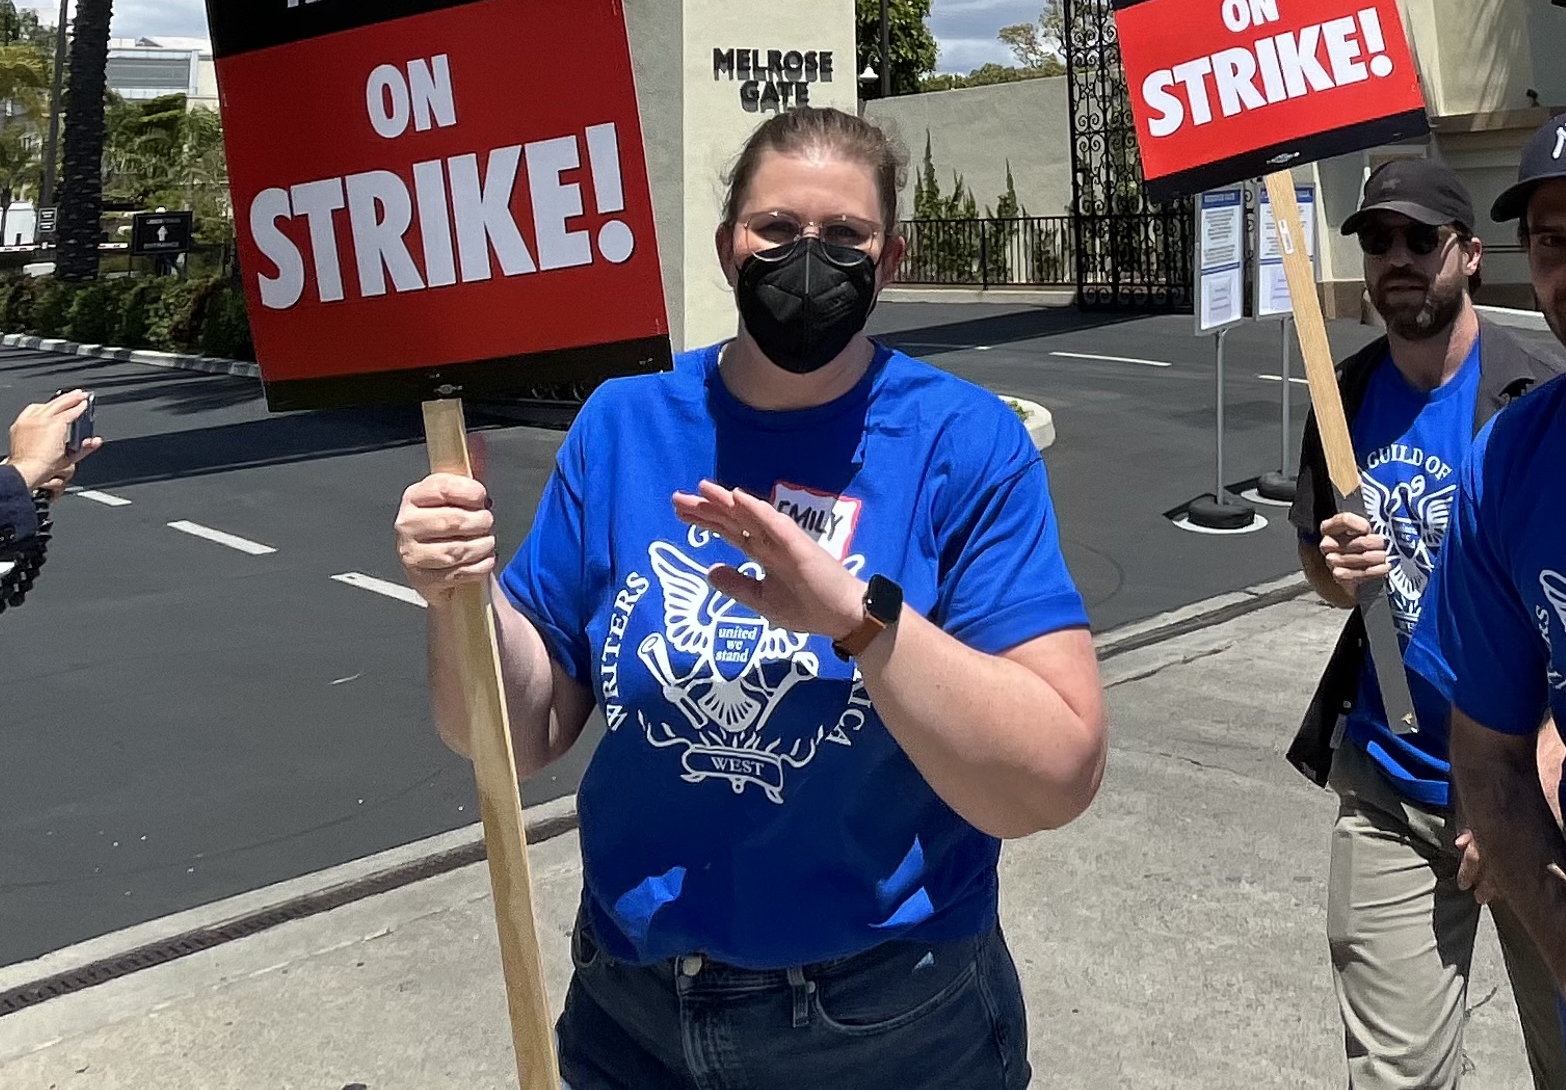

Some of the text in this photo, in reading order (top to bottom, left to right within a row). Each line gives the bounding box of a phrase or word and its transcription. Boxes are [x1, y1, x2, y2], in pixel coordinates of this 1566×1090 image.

[713, 48, 833, 79] MELROSE
[1142, 7, 1394, 138] STRIKE!
[366, 54, 457, 140] ON
[740, 81, 810, 109] GATE
[250, 122, 636, 311] STRIKE!
[1367, 443, 1452, 481] GUILD OF
[718, 626, 757, 641] united
[726, 640, 743, 650] we
[600, 572, 650, 731] WRITERS
[715, 648, 750, 662] stand
[710, 756, 765, 776] WEST
